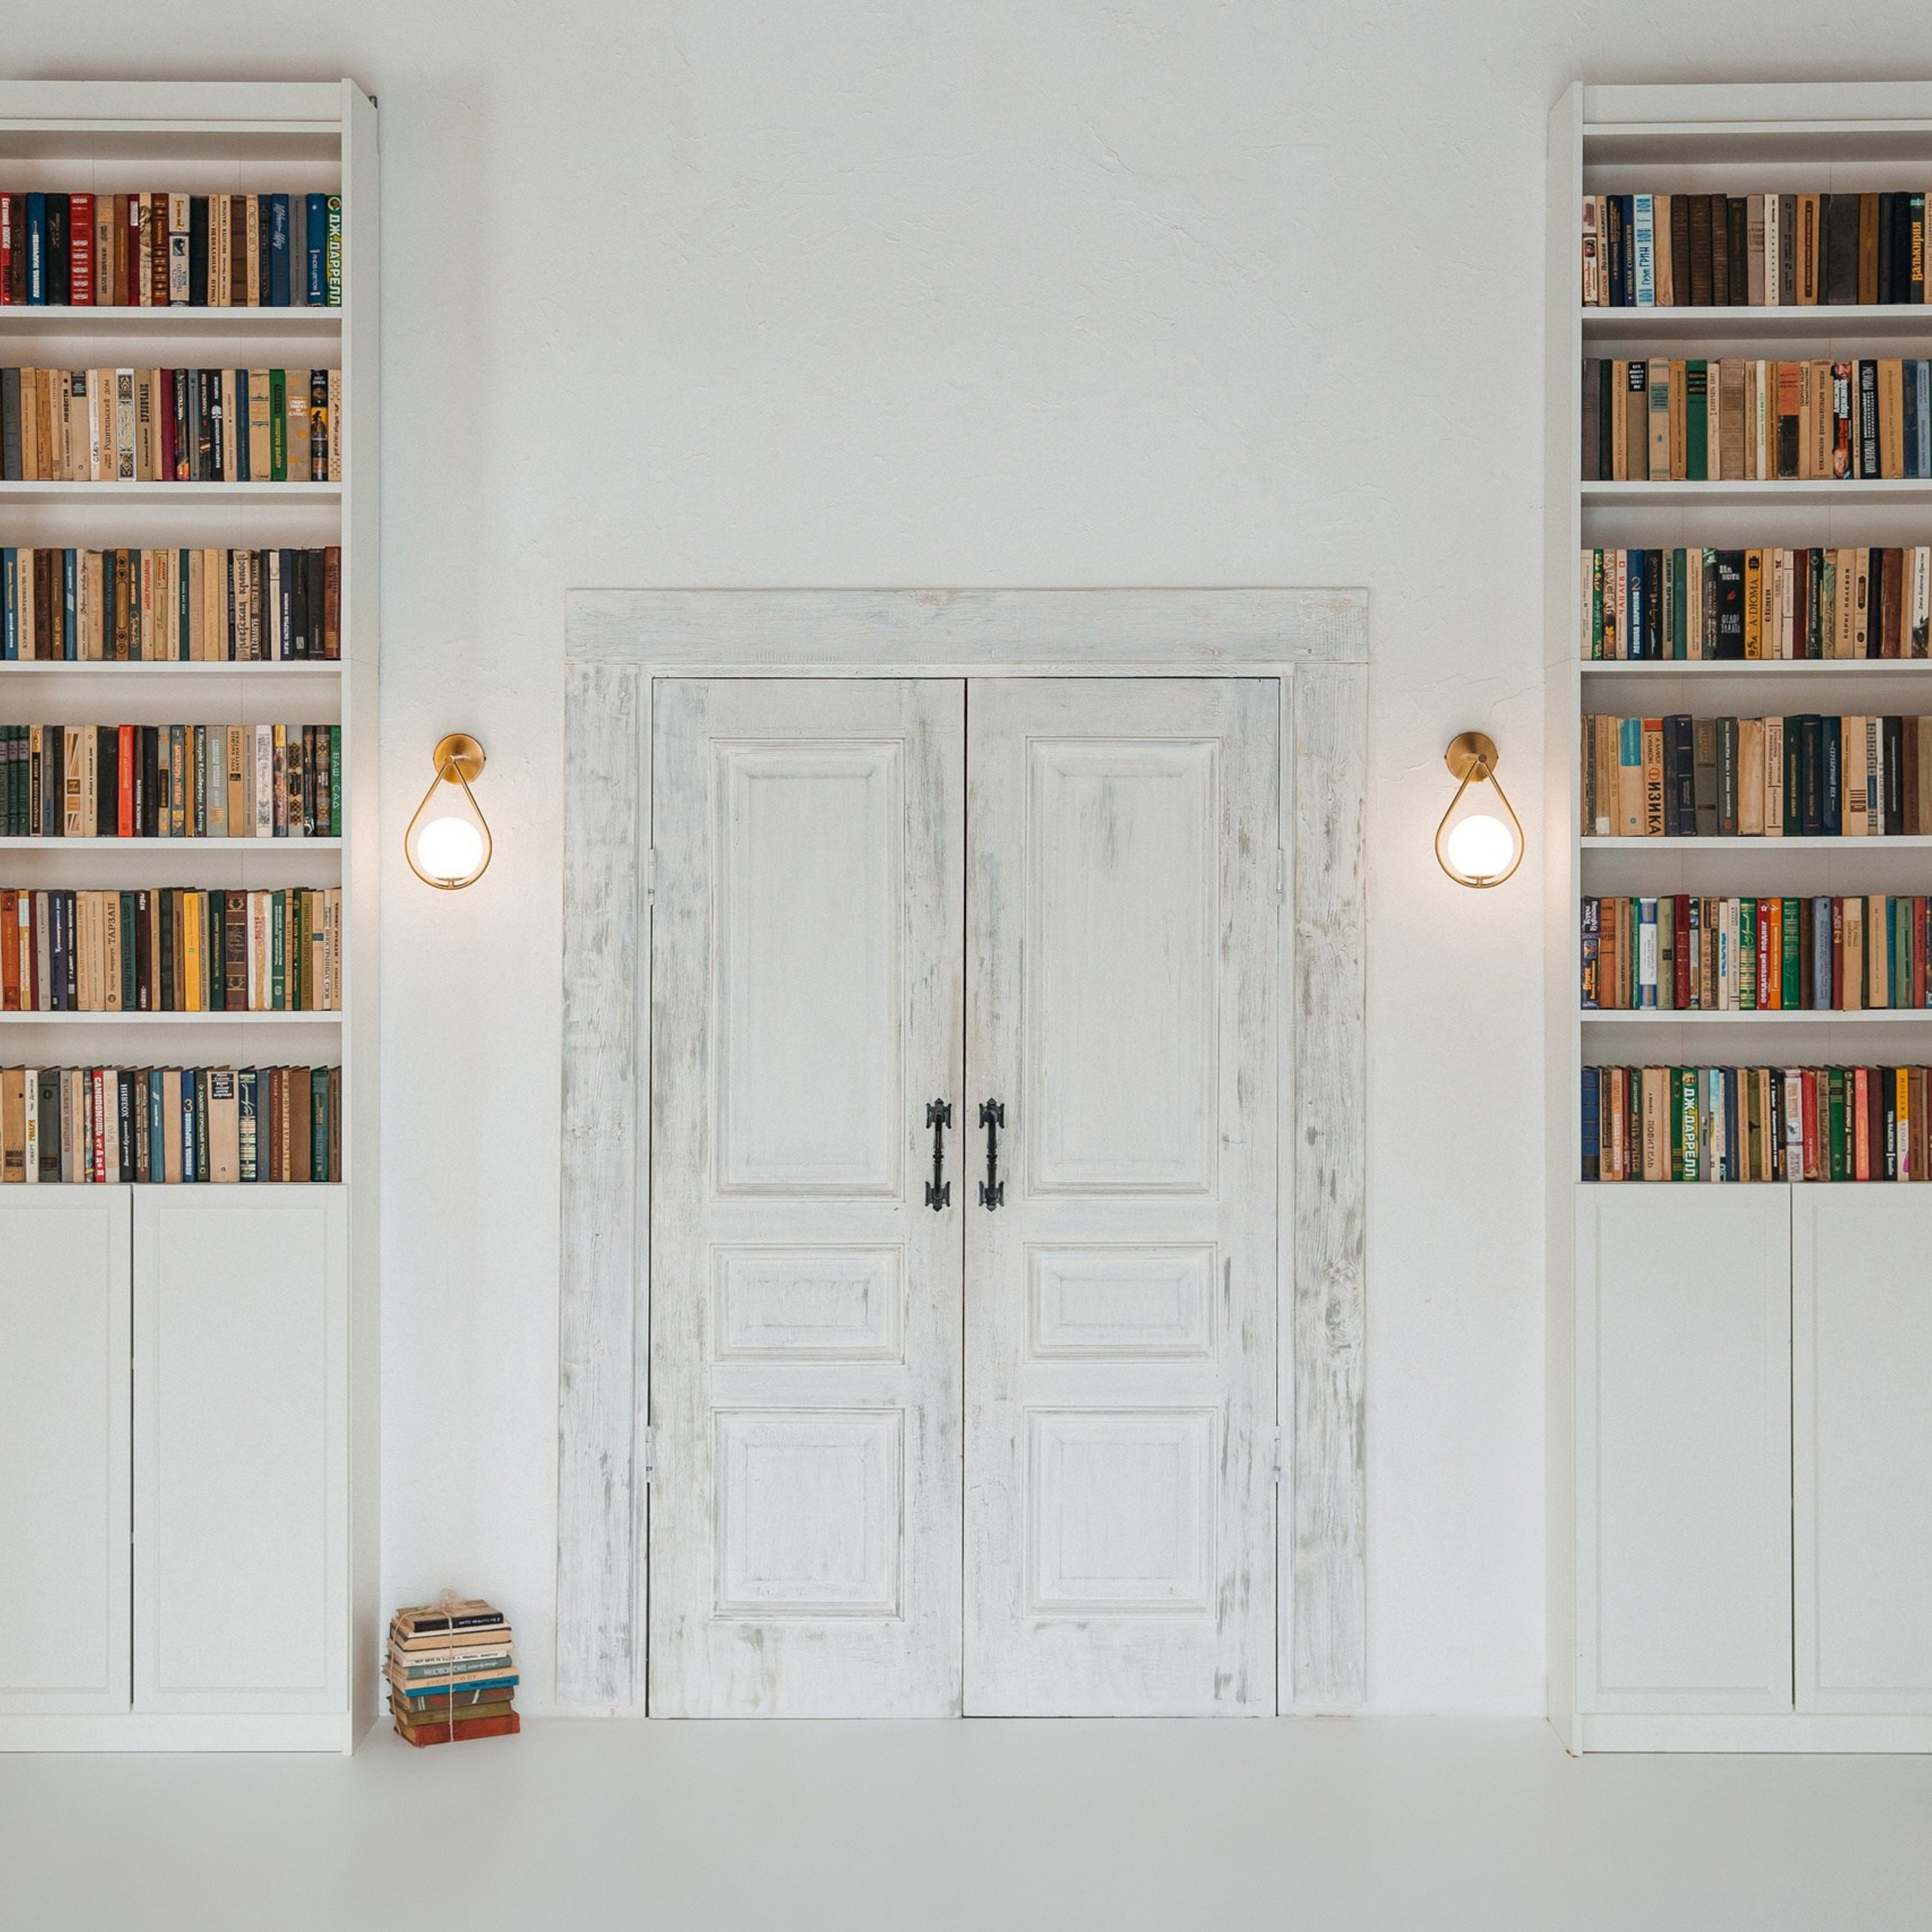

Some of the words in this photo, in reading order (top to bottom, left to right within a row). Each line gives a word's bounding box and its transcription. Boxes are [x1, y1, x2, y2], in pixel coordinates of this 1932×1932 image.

[329, 214, 340, 304] ДЖ.ДАРРЕЛЛ
[1638, 247, 1650, 267] ГРИН
[1912, 221, 1924, 281] Валькирия
[1604, 553, 1615, 614] КАРУСЕЛЬ
[1631, 577, 1641, 591] 2
[1648, 767, 1662, 835] ФИЗИКА
[1759, 953, 1768, 1003] СОЛДАТСКИЙ
[94, 1077, 103, 1136] САМОПОМОЩЬ
[121, 1084, 129, 1118] ХОЗЯИН
[183, 1098, 193, 1112] 3
[97, 1139, 102, 1149] от
[1684, 1088, 1697, 1177] ДЖ.ДАРРЕЛЛ
[96, 1157, 103, 1168] до
